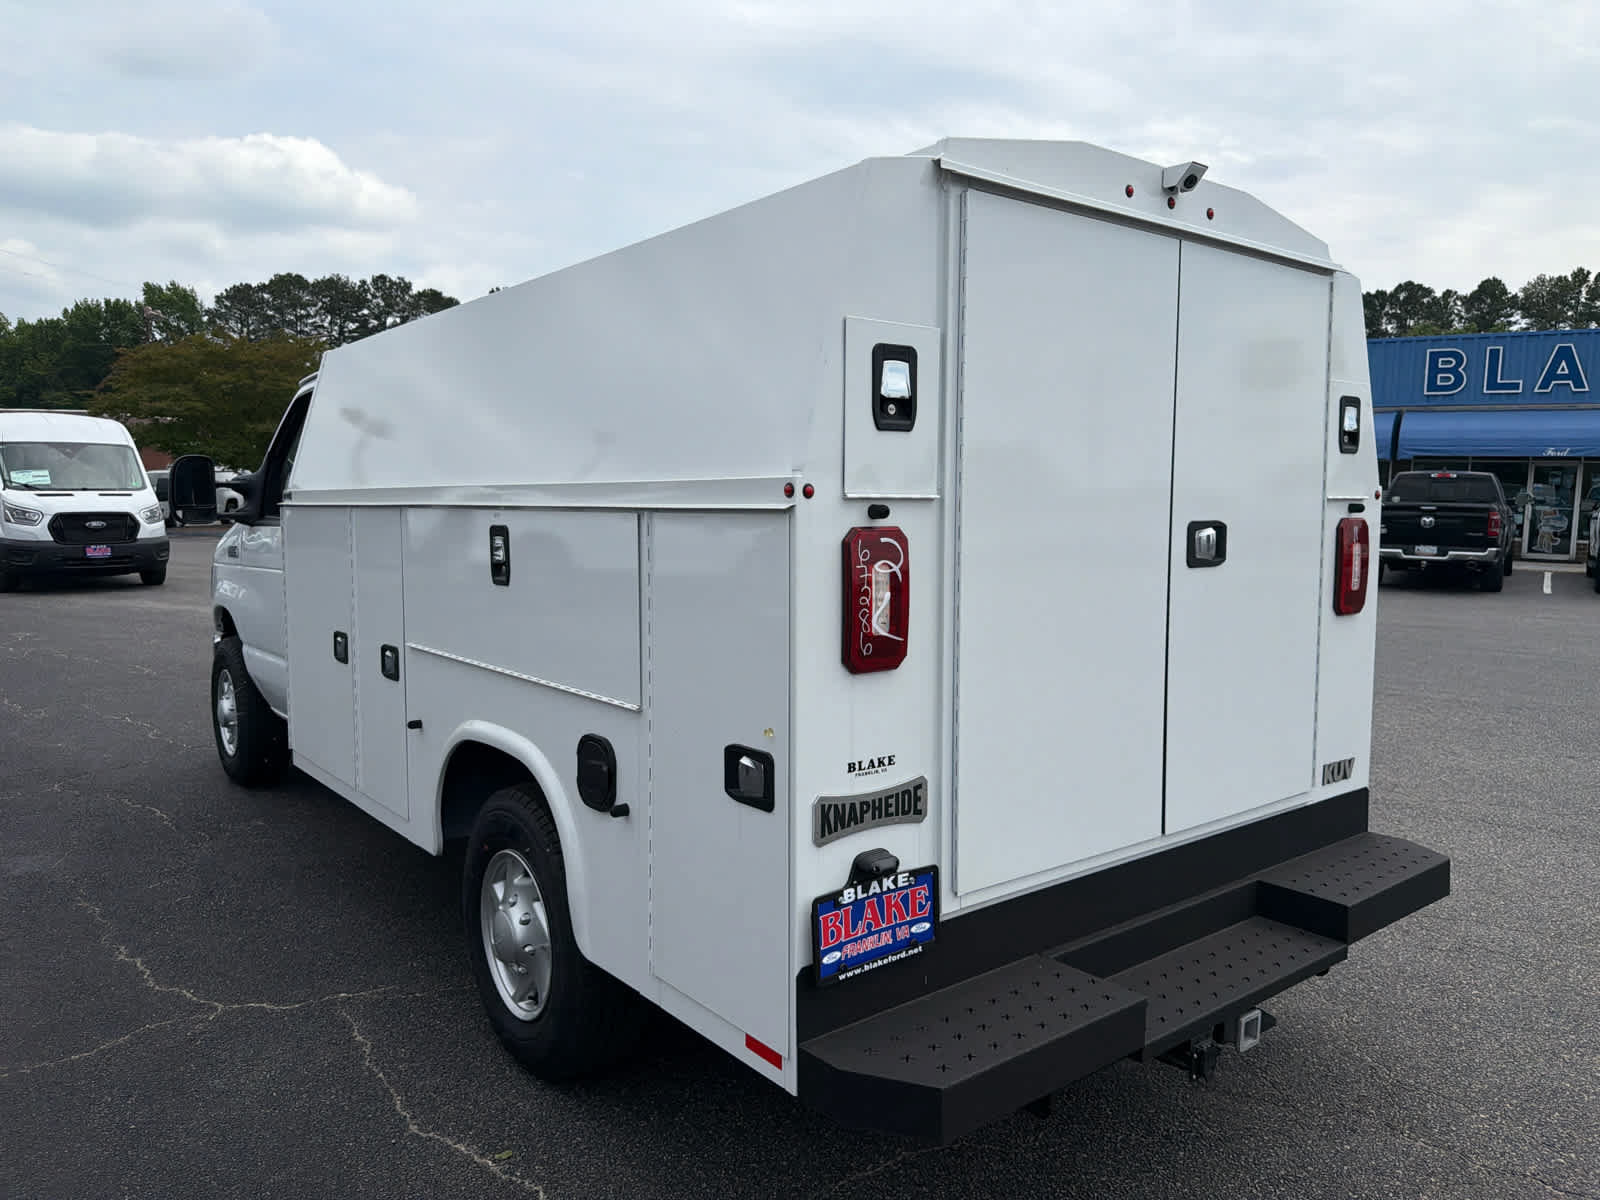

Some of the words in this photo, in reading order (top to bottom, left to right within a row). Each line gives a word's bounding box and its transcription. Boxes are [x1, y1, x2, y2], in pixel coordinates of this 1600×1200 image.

[1423, 343, 1590, 396] BLA
[847, 754, 896, 774] BLAKE
[820, 783, 923, 839] KNAPHEIDE
[841, 872, 910, 904] BLAKE
[820, 884, 931, 950] BLAKE
[895, 925, 910, 941] VA
[838, 945, 923, 981] www.blakeford.net
